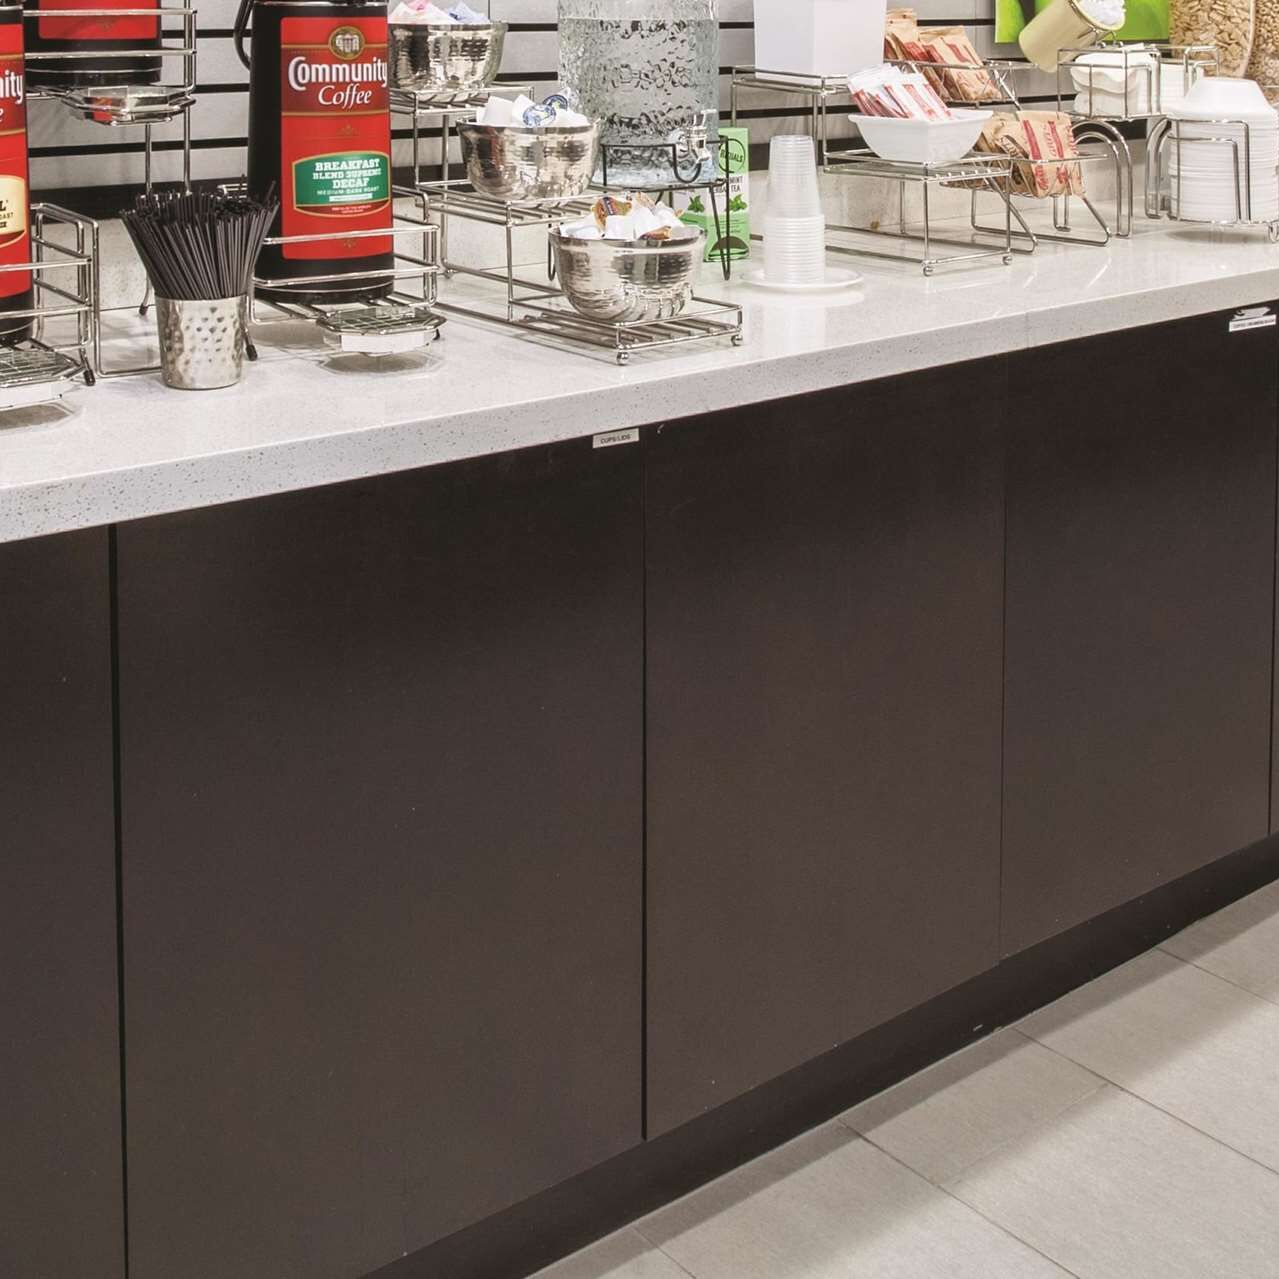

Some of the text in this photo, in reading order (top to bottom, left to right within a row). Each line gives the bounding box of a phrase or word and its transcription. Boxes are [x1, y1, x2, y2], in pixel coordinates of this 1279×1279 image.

[287, 56, 387, 91] Community
[318, 83, 372, 109] Coffee
[720, 149, 743, 163] RUALS
[314, 158, 380, 171] BREAKFAST
[332, 178, 369, 189] DECAF
